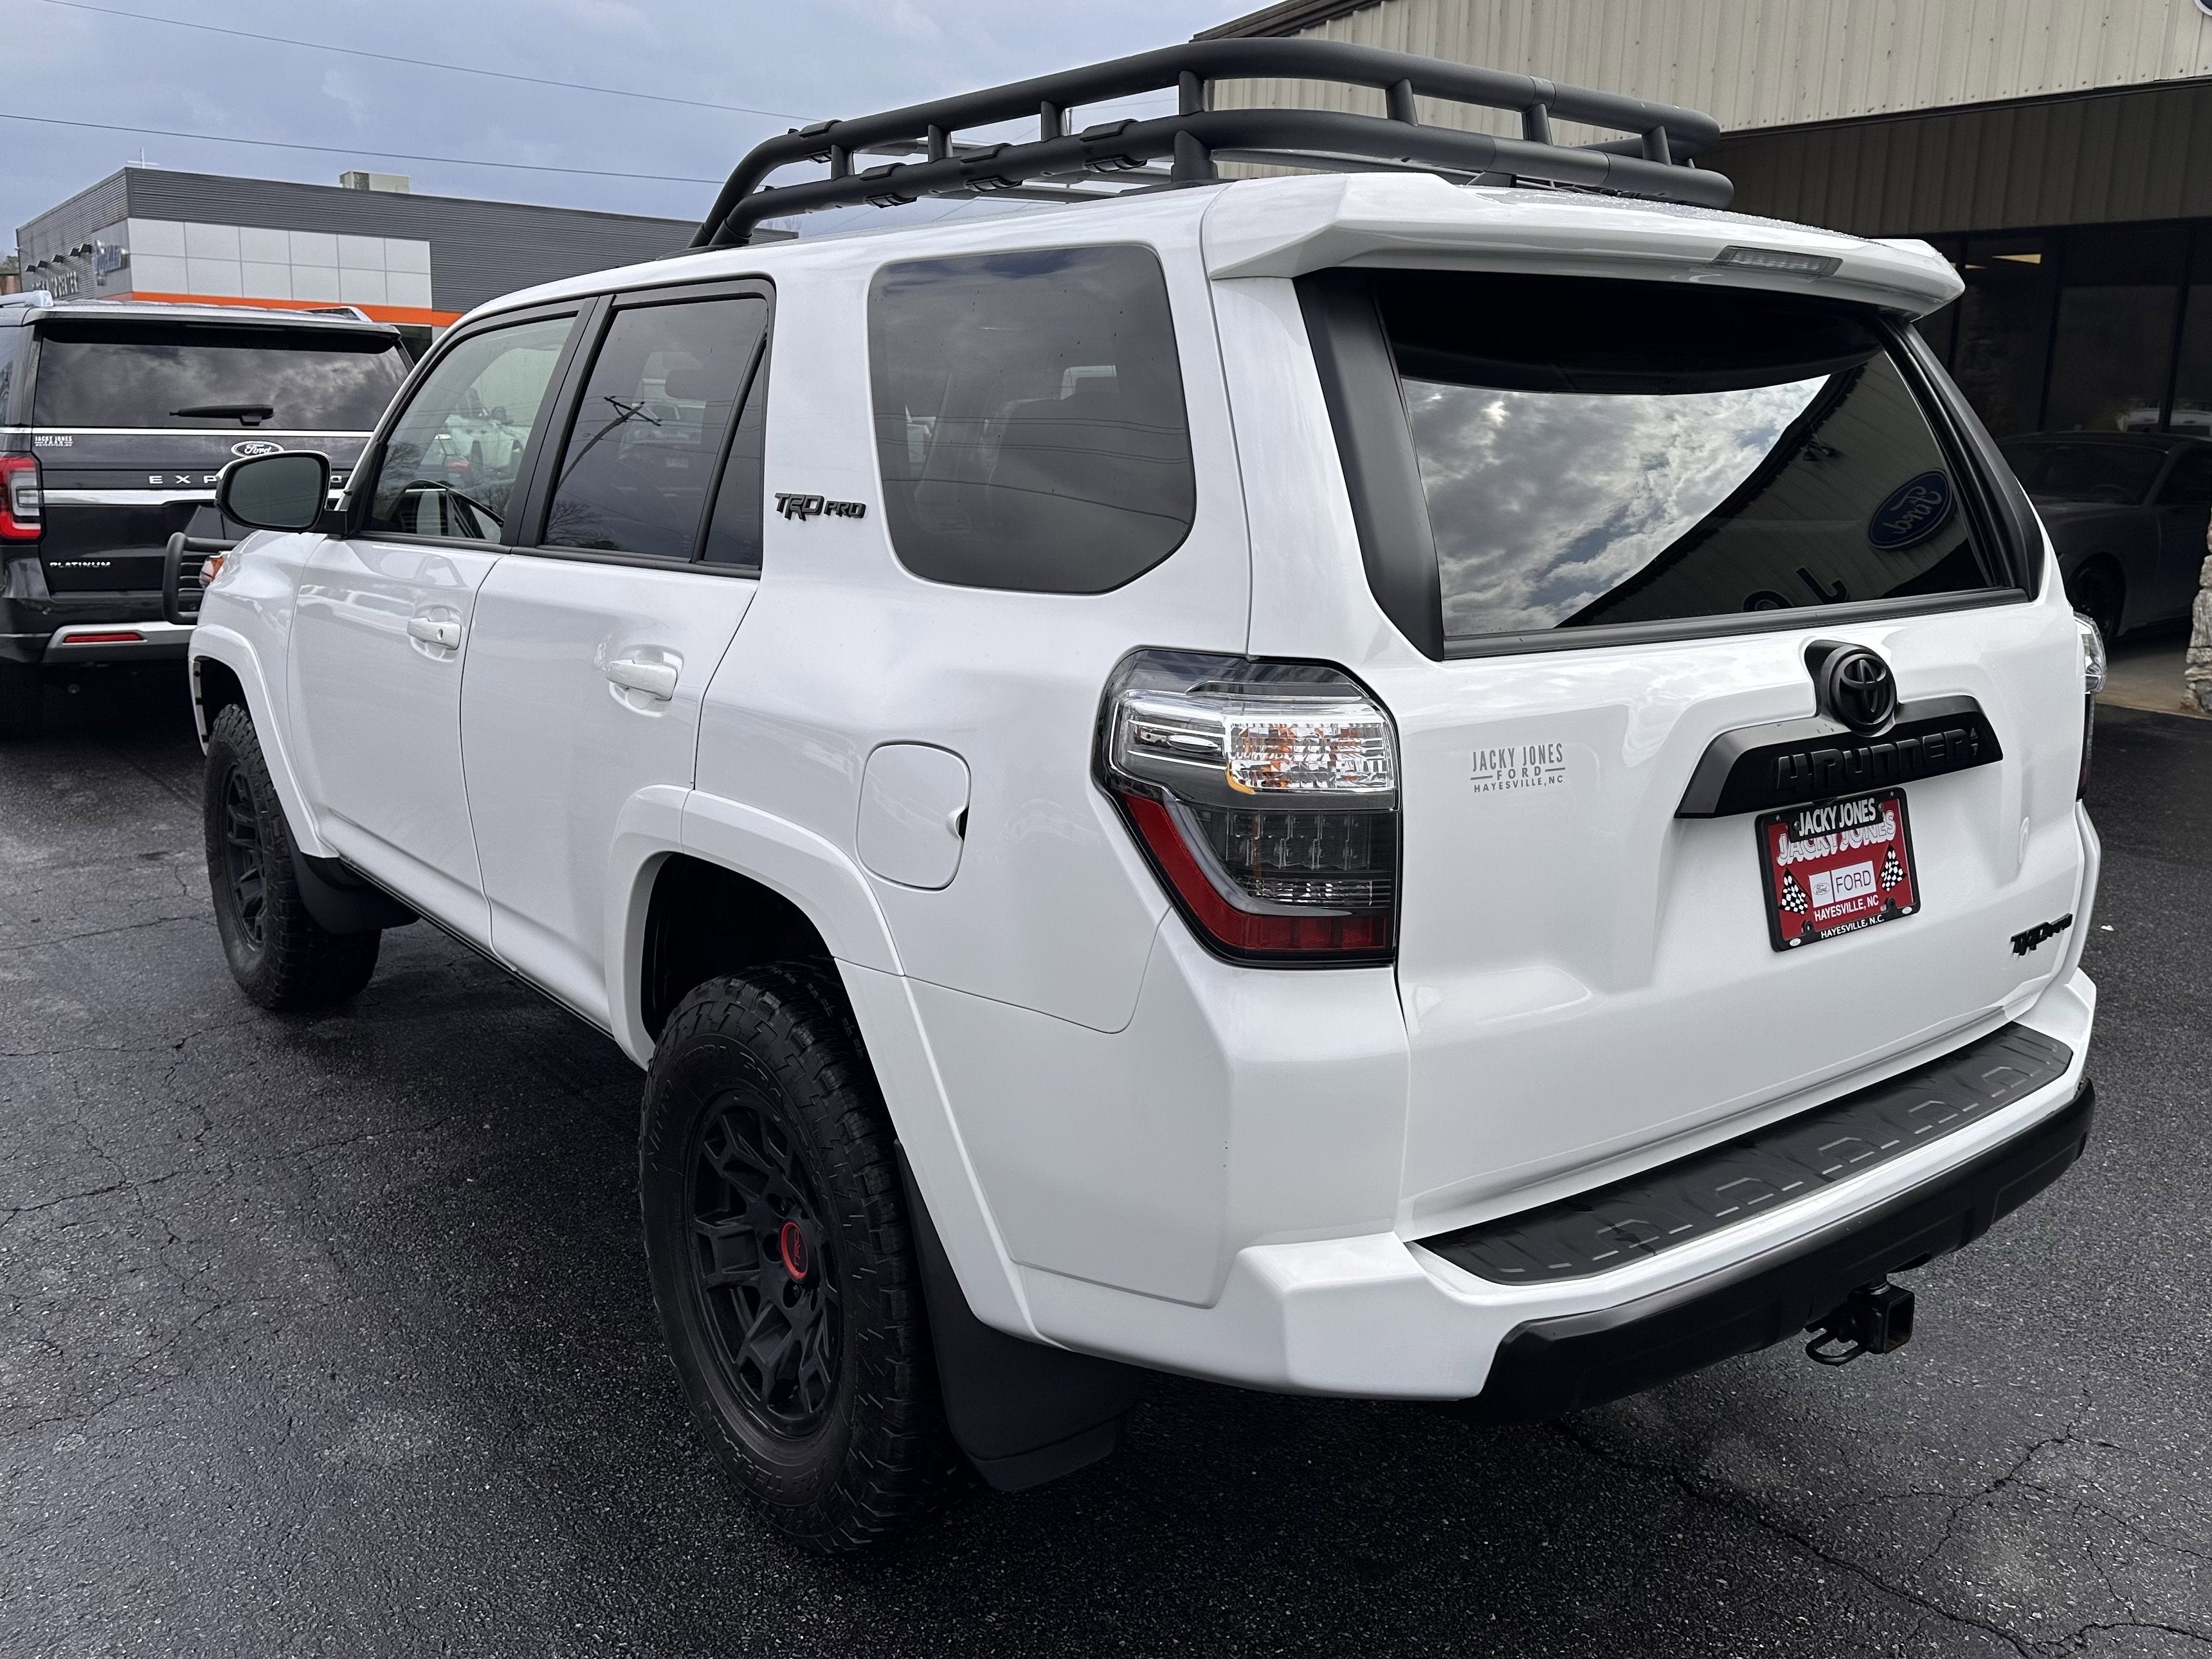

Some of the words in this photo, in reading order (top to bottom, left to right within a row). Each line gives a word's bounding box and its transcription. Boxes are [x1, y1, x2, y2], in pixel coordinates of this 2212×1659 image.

[244, 444, 273, 455] Ford
[775, 493, 824, 521] TRD
[824, 500, 866, 519] PRO
[1473, 747, 1515, 772] JACKY
[1523, 743, 1563, 766] JONES
[1496, 766, 1541, 780] FORD
[1799, 805, 1838, 837] JACKY
[1838, 797, 1876, 828] JONES
[1835, 870, 1871, 894] FORD
[1814, 902, 1866, 922] HAYESVILLE,
[1867, 894, 1879, 909] NC
[1820, 918, 1868, 939] HAYESVILLE,
[1869, 914, 1885, 925] N.C.
